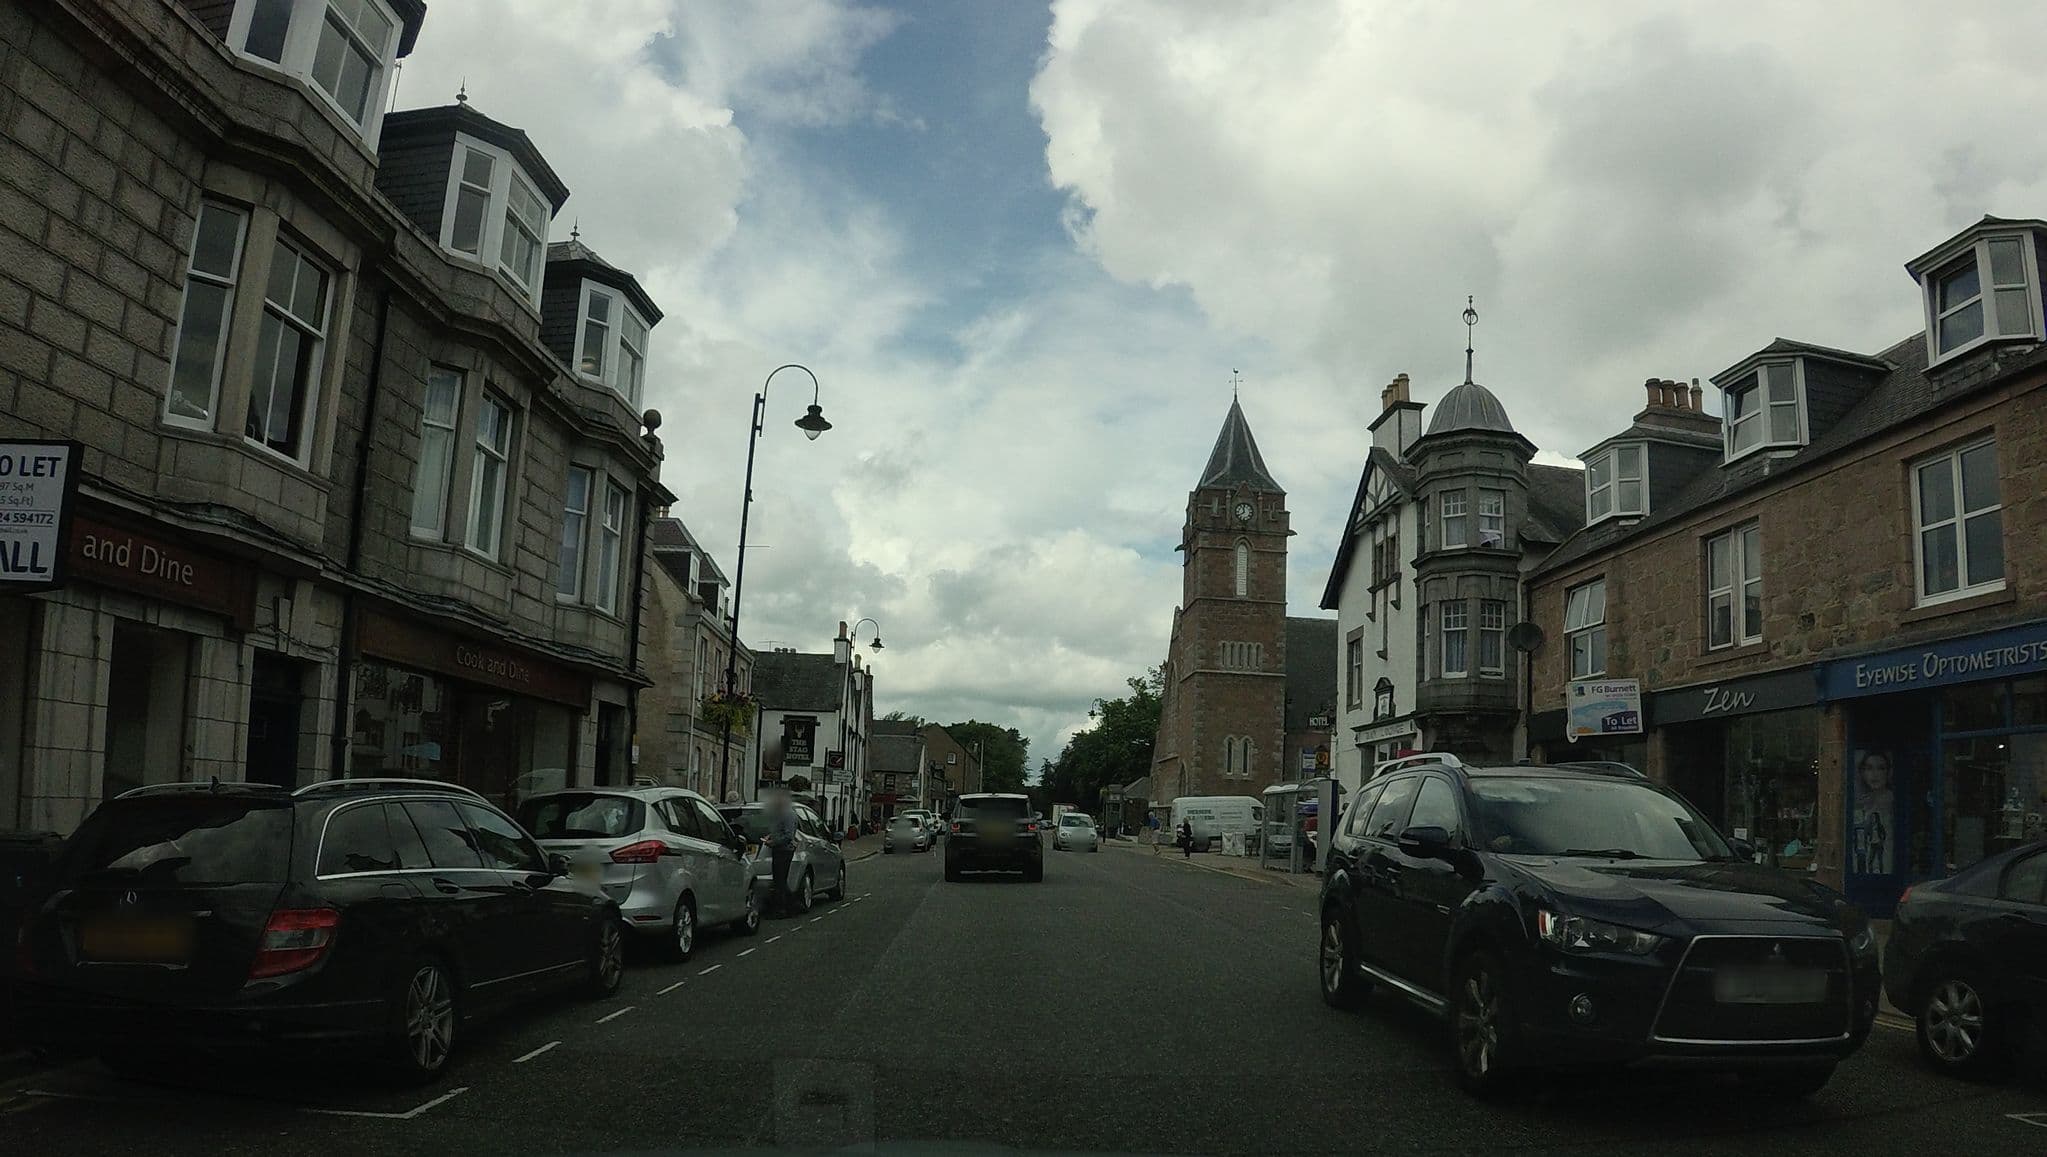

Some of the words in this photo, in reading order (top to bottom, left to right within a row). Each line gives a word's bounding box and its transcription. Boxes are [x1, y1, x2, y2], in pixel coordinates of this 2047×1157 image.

[19, 456, 62, 478] LET
[13, 512, 54, 524] 594172
[83, 534, 132, 568] and
[140, 545, 194, 585] Dine
[456, 645, 484, 671] Cook
[487, 656, 507, 676] and
[509, 660, 530, 683] Dine
[1855, 663, 1918, 688] EYEWISE
[1591, 685, 1603, 694] FG
[1604, 684, 1637, 693] Burnett
[1702, 686, 1755, 714] Zen
[1309, 716, 1330, 727] HOTEL
[1605, 716, 1618, 726] To
[1621, 716, 1638, 725] Let
[786, 752, 810, 760] HOTEL
